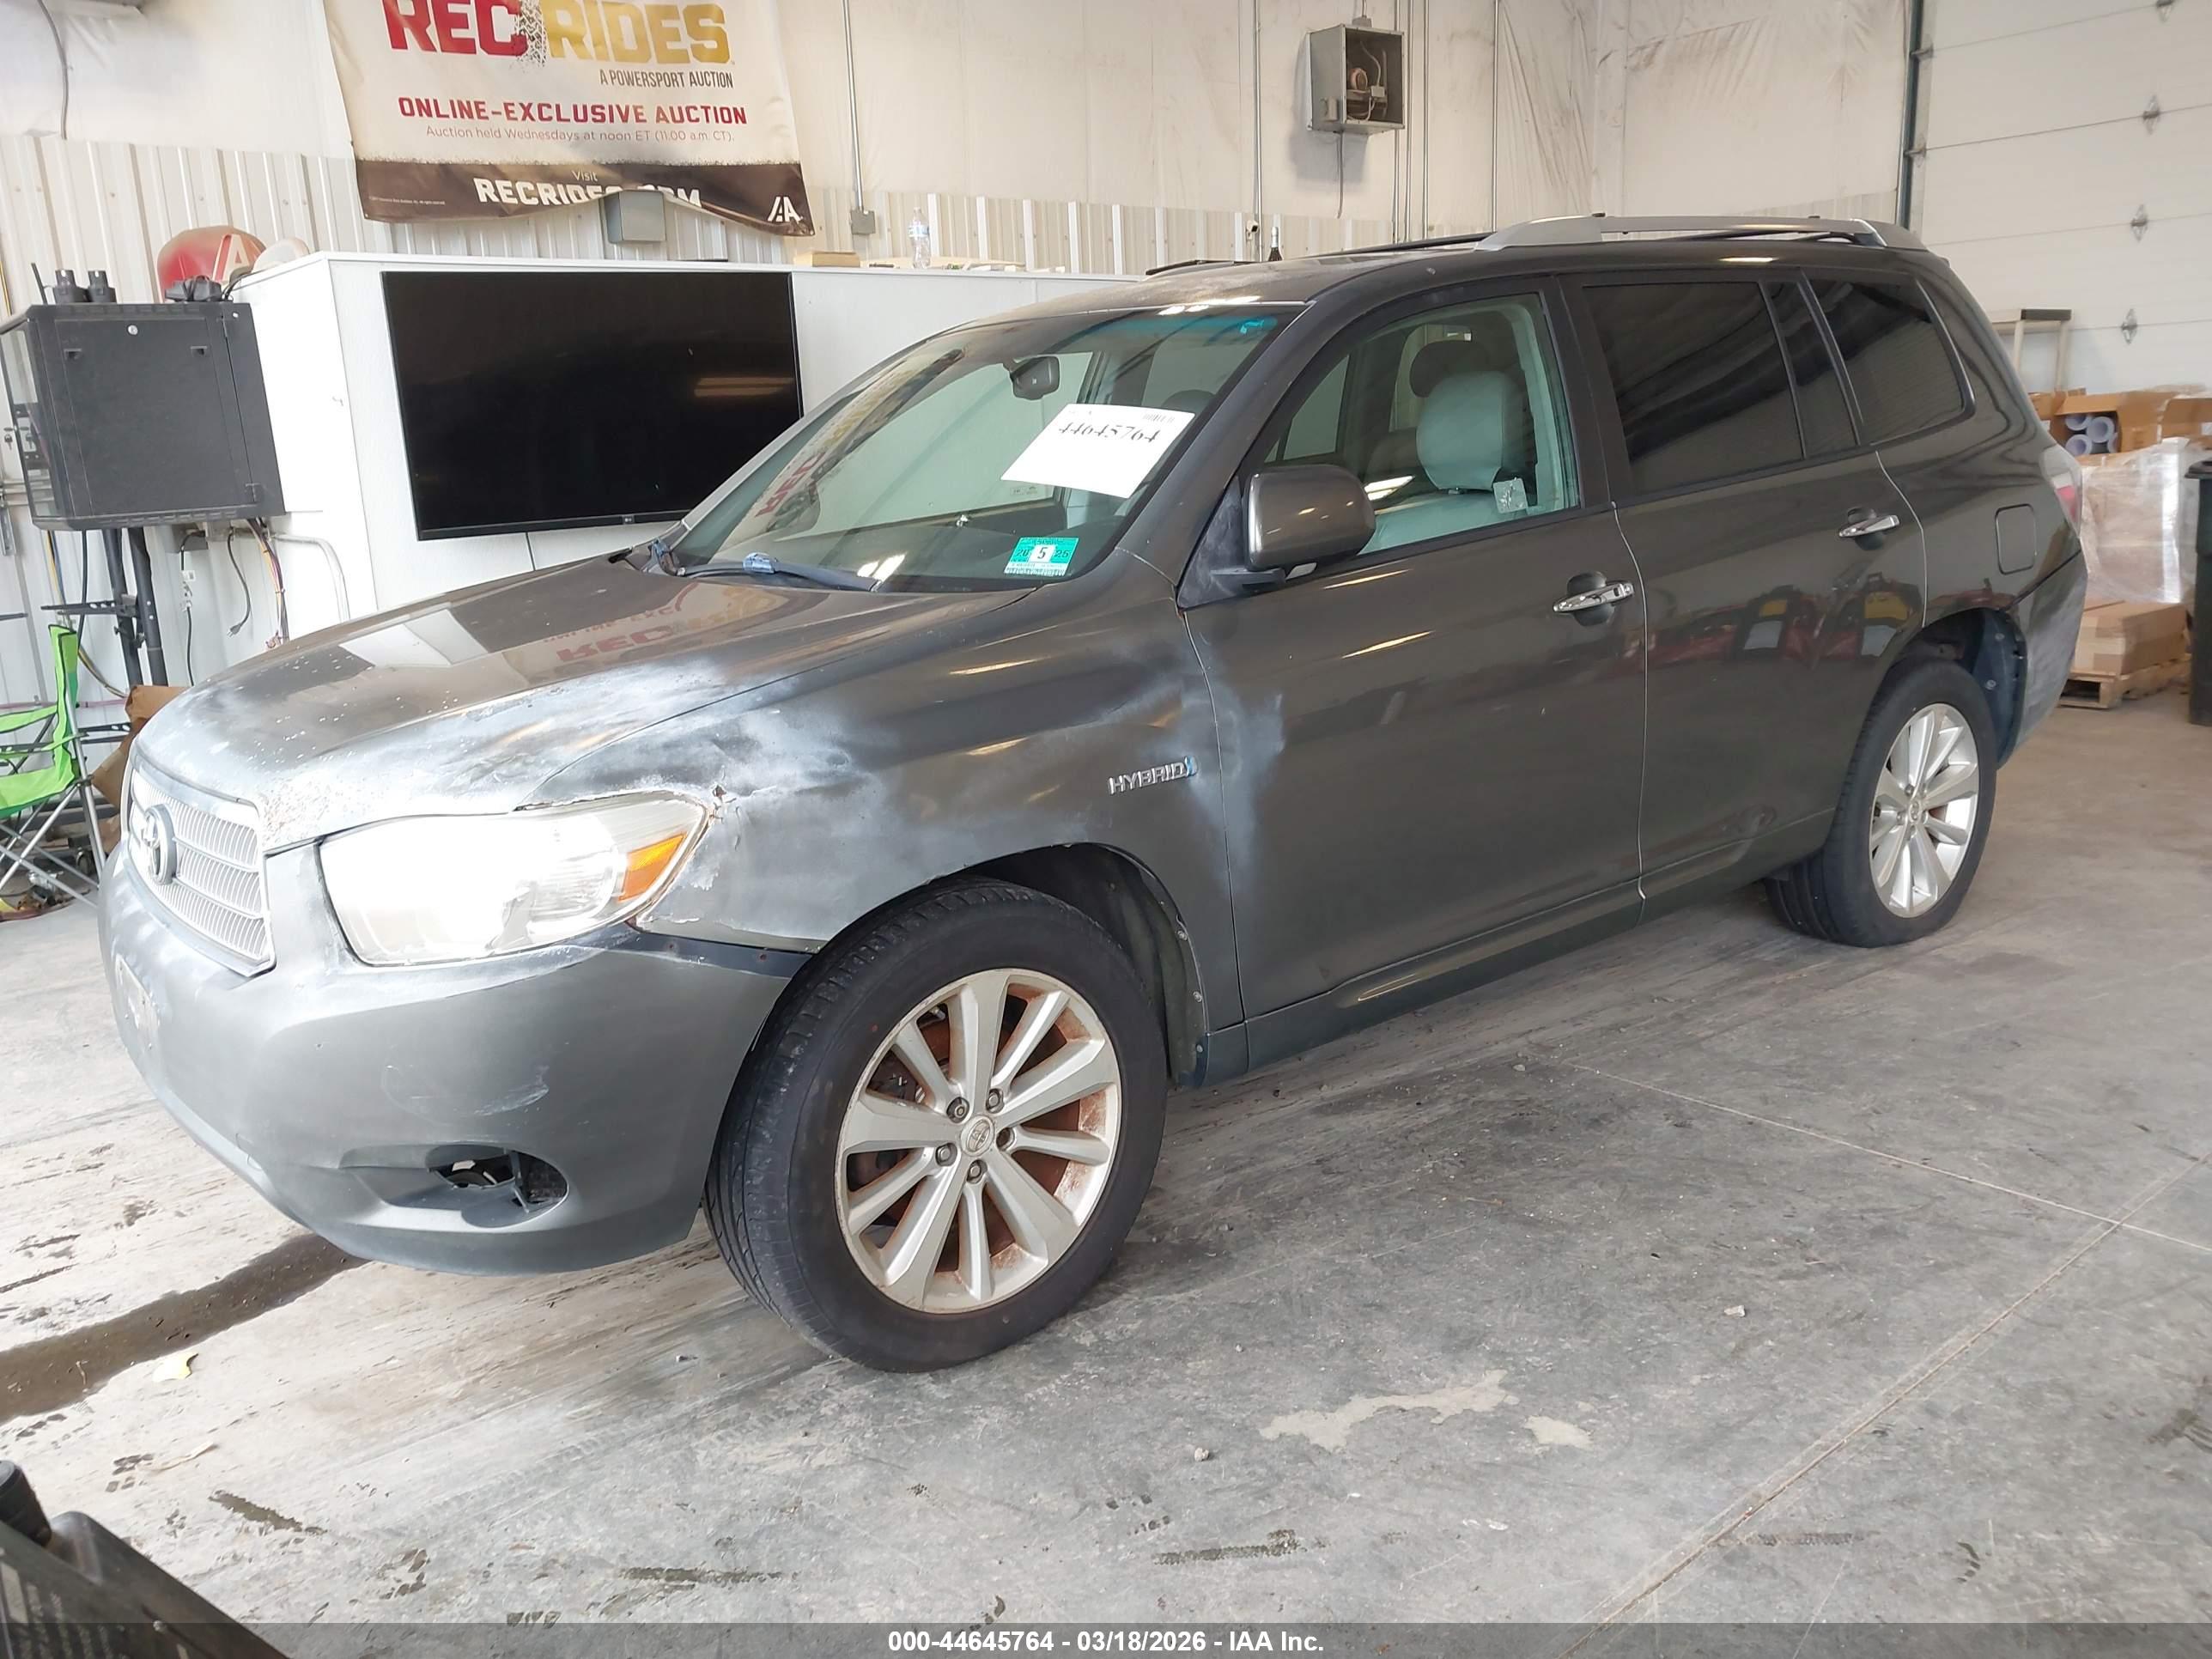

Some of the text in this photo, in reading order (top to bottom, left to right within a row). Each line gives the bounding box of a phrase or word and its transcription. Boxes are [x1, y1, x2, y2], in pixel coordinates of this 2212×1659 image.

[382, 0, 731, 64] REC RIDES
[600, 69, 733, 88] A POWERSPORT AUCTION
[398, 97, 747, 125] ONLINE-EXCLUSIVE AUCTION
[426, 126, 473, 138] Auction
[477, 128, 501, 138] held
[505, 129, 580, 142] Wednesdays
[583, 131, 595, 141] at
[600, 131, 631, 141] noon
[635, 131, 650, 141] ET
[571, 171, 598, 182] Visit
[1036, 546, 1048, 560] 5
[1109, 762, 1188, 794] HYBRID
